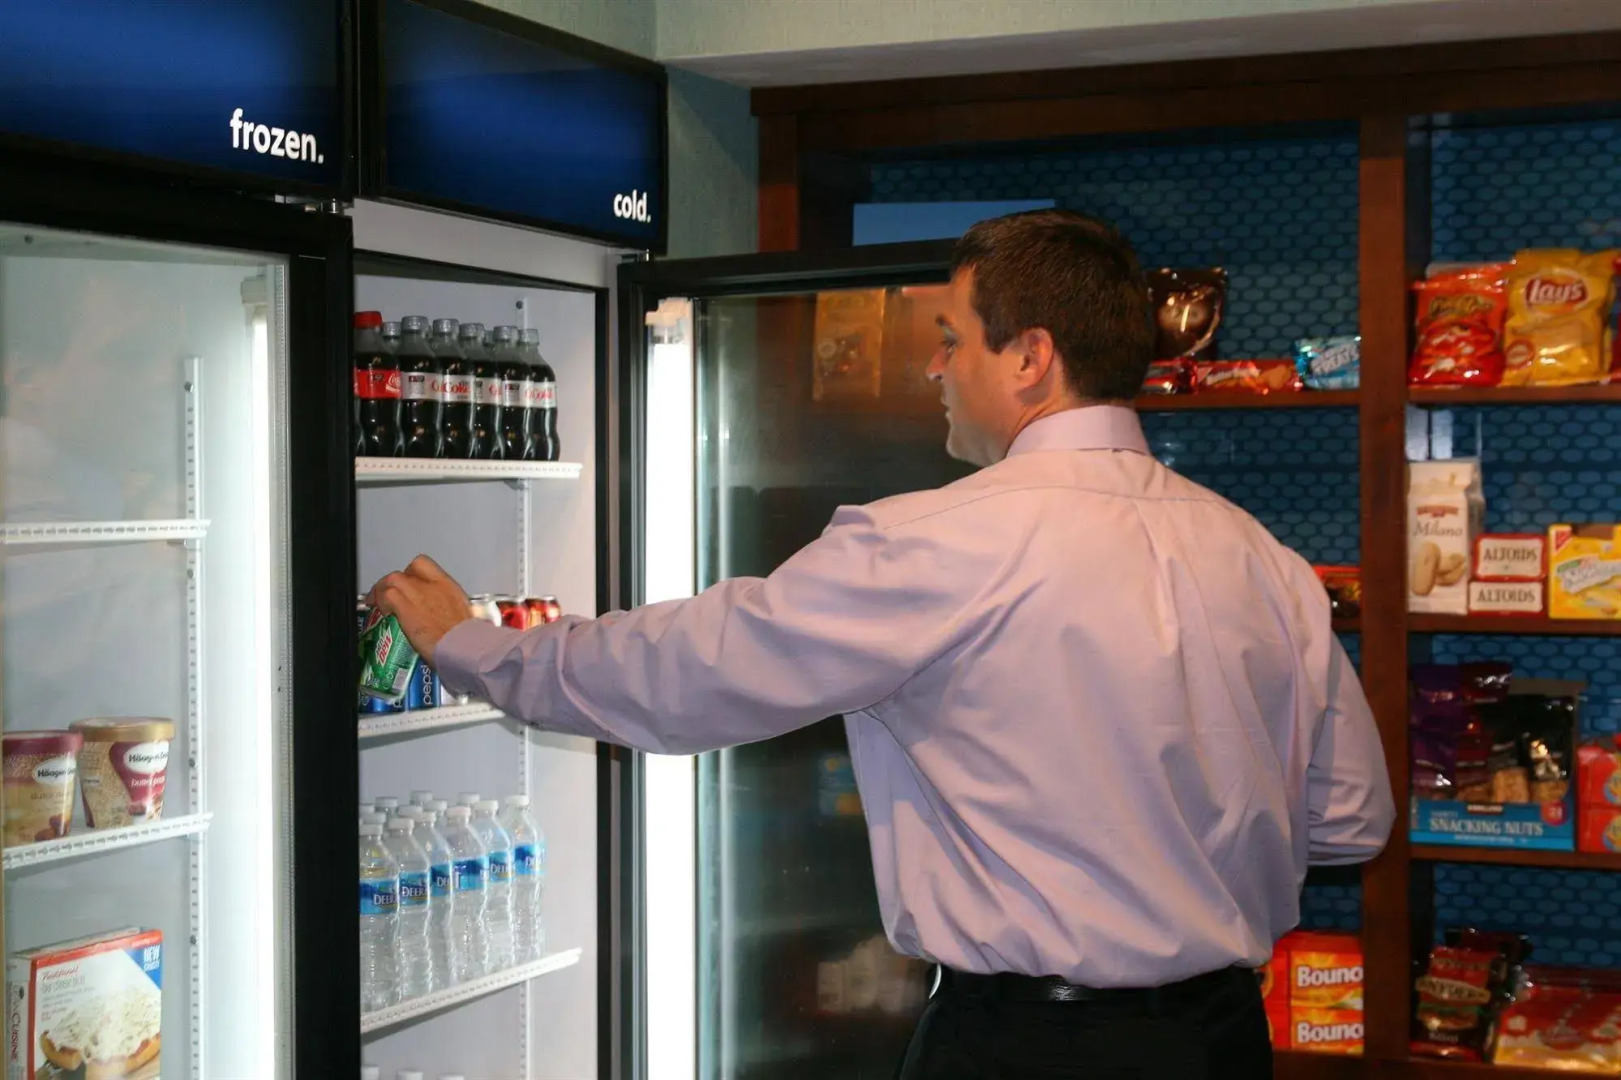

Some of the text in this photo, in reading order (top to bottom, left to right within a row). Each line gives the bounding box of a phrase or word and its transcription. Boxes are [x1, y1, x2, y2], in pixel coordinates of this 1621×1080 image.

[230, 107, 325, 165] frozen.
[613, 188, 652, 223] cold.
[1413, 521, 1463, 537] Milano
[1483, 549, 1537, 562] ALTOIDS
[1477, 589, 1536, 603] ALTOIDS
[421, 664, 434, 706] pepsi
[1430, 819, 1544, 837] SNACKING NUTS
[1297, 966, 1363, 987] Bounc
[11, 1013, 21, 1063] CUISINE
[1297, 1022, 1363, 1043] Bounc
